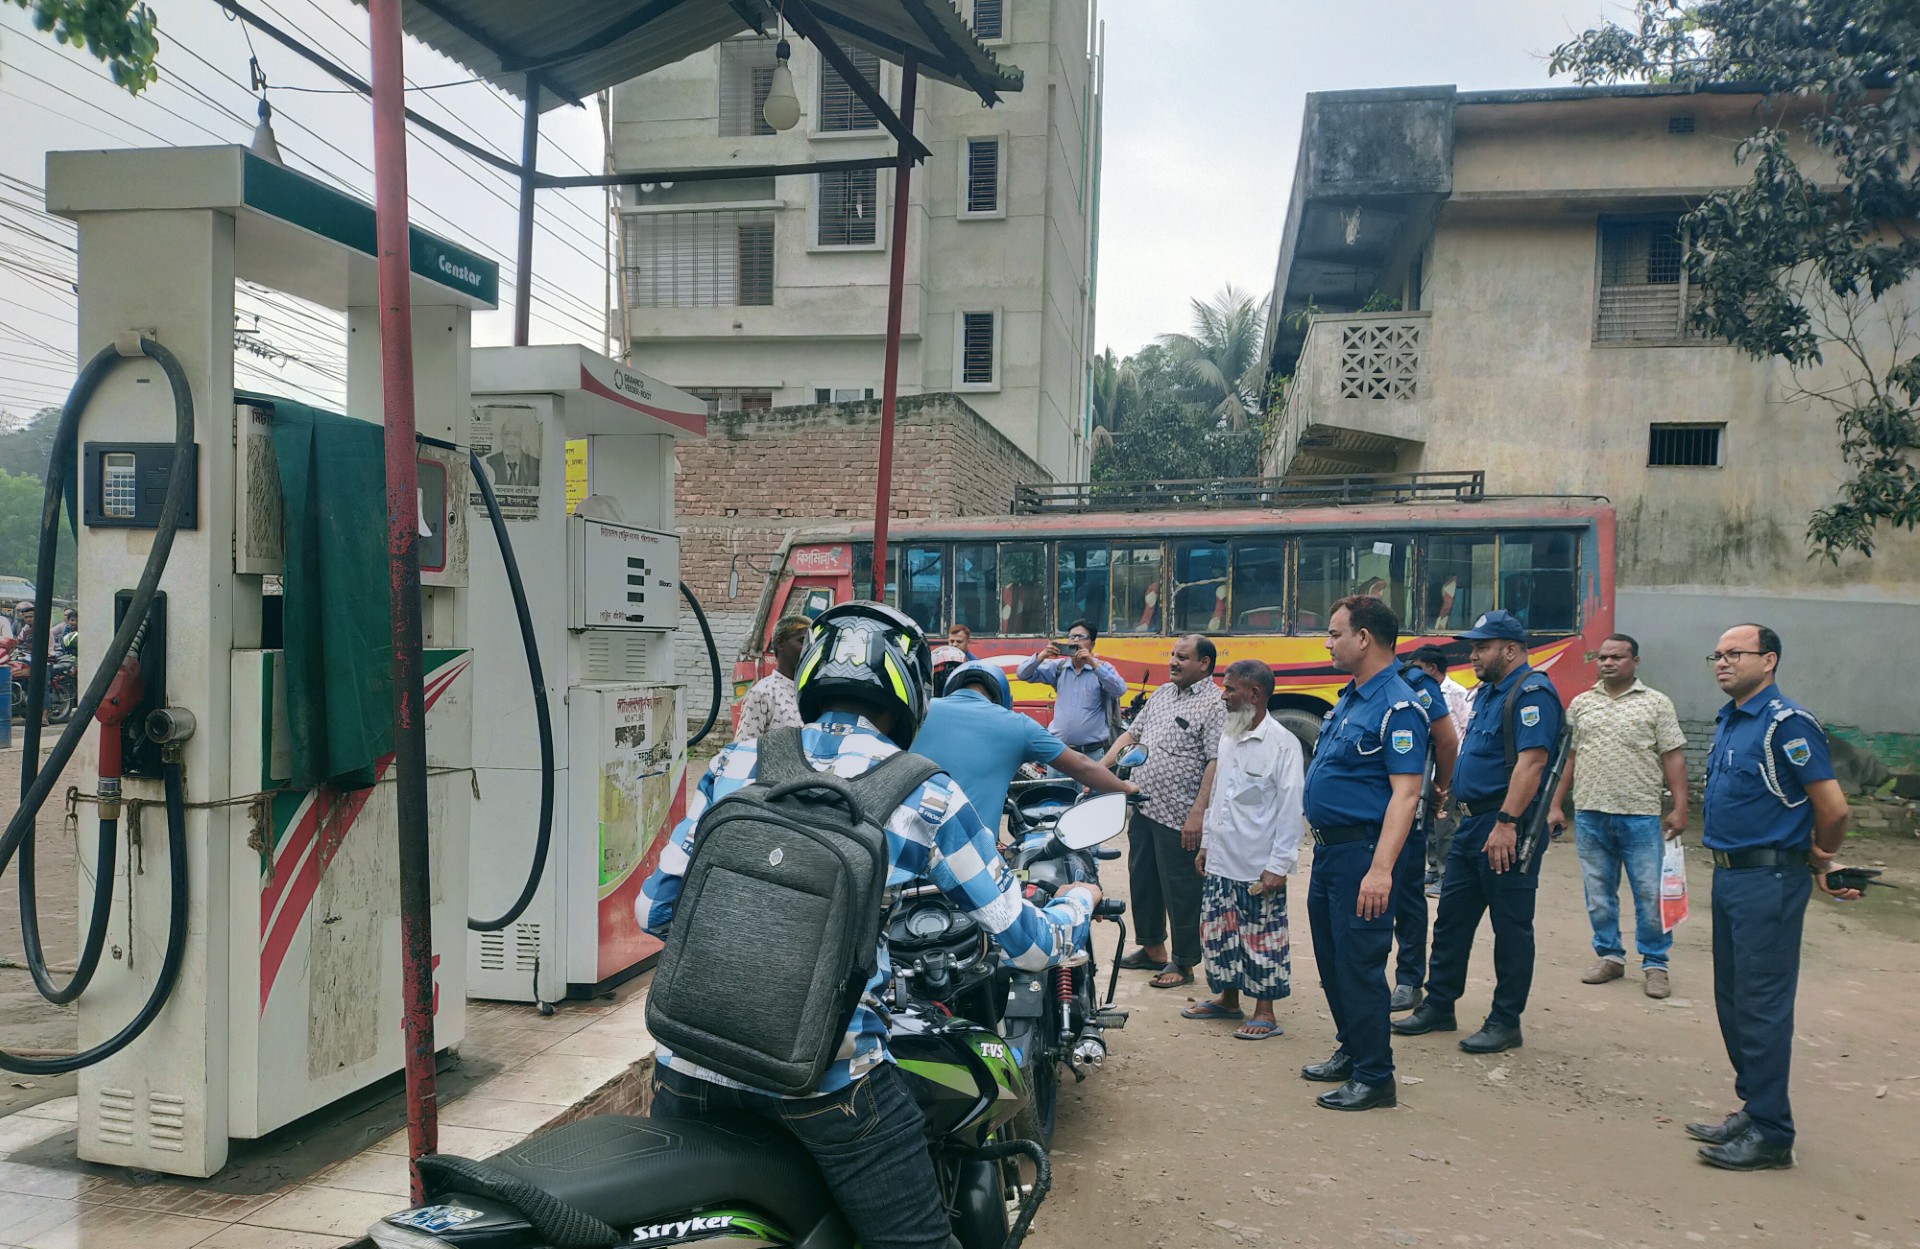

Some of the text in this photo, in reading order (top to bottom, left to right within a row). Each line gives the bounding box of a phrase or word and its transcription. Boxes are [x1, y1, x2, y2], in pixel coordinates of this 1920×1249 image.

[439, 255, 481, 286] Censtar
[980, 1042, 1003, 1058] TVS
[633, 1214, 734, 1242] Stryker
